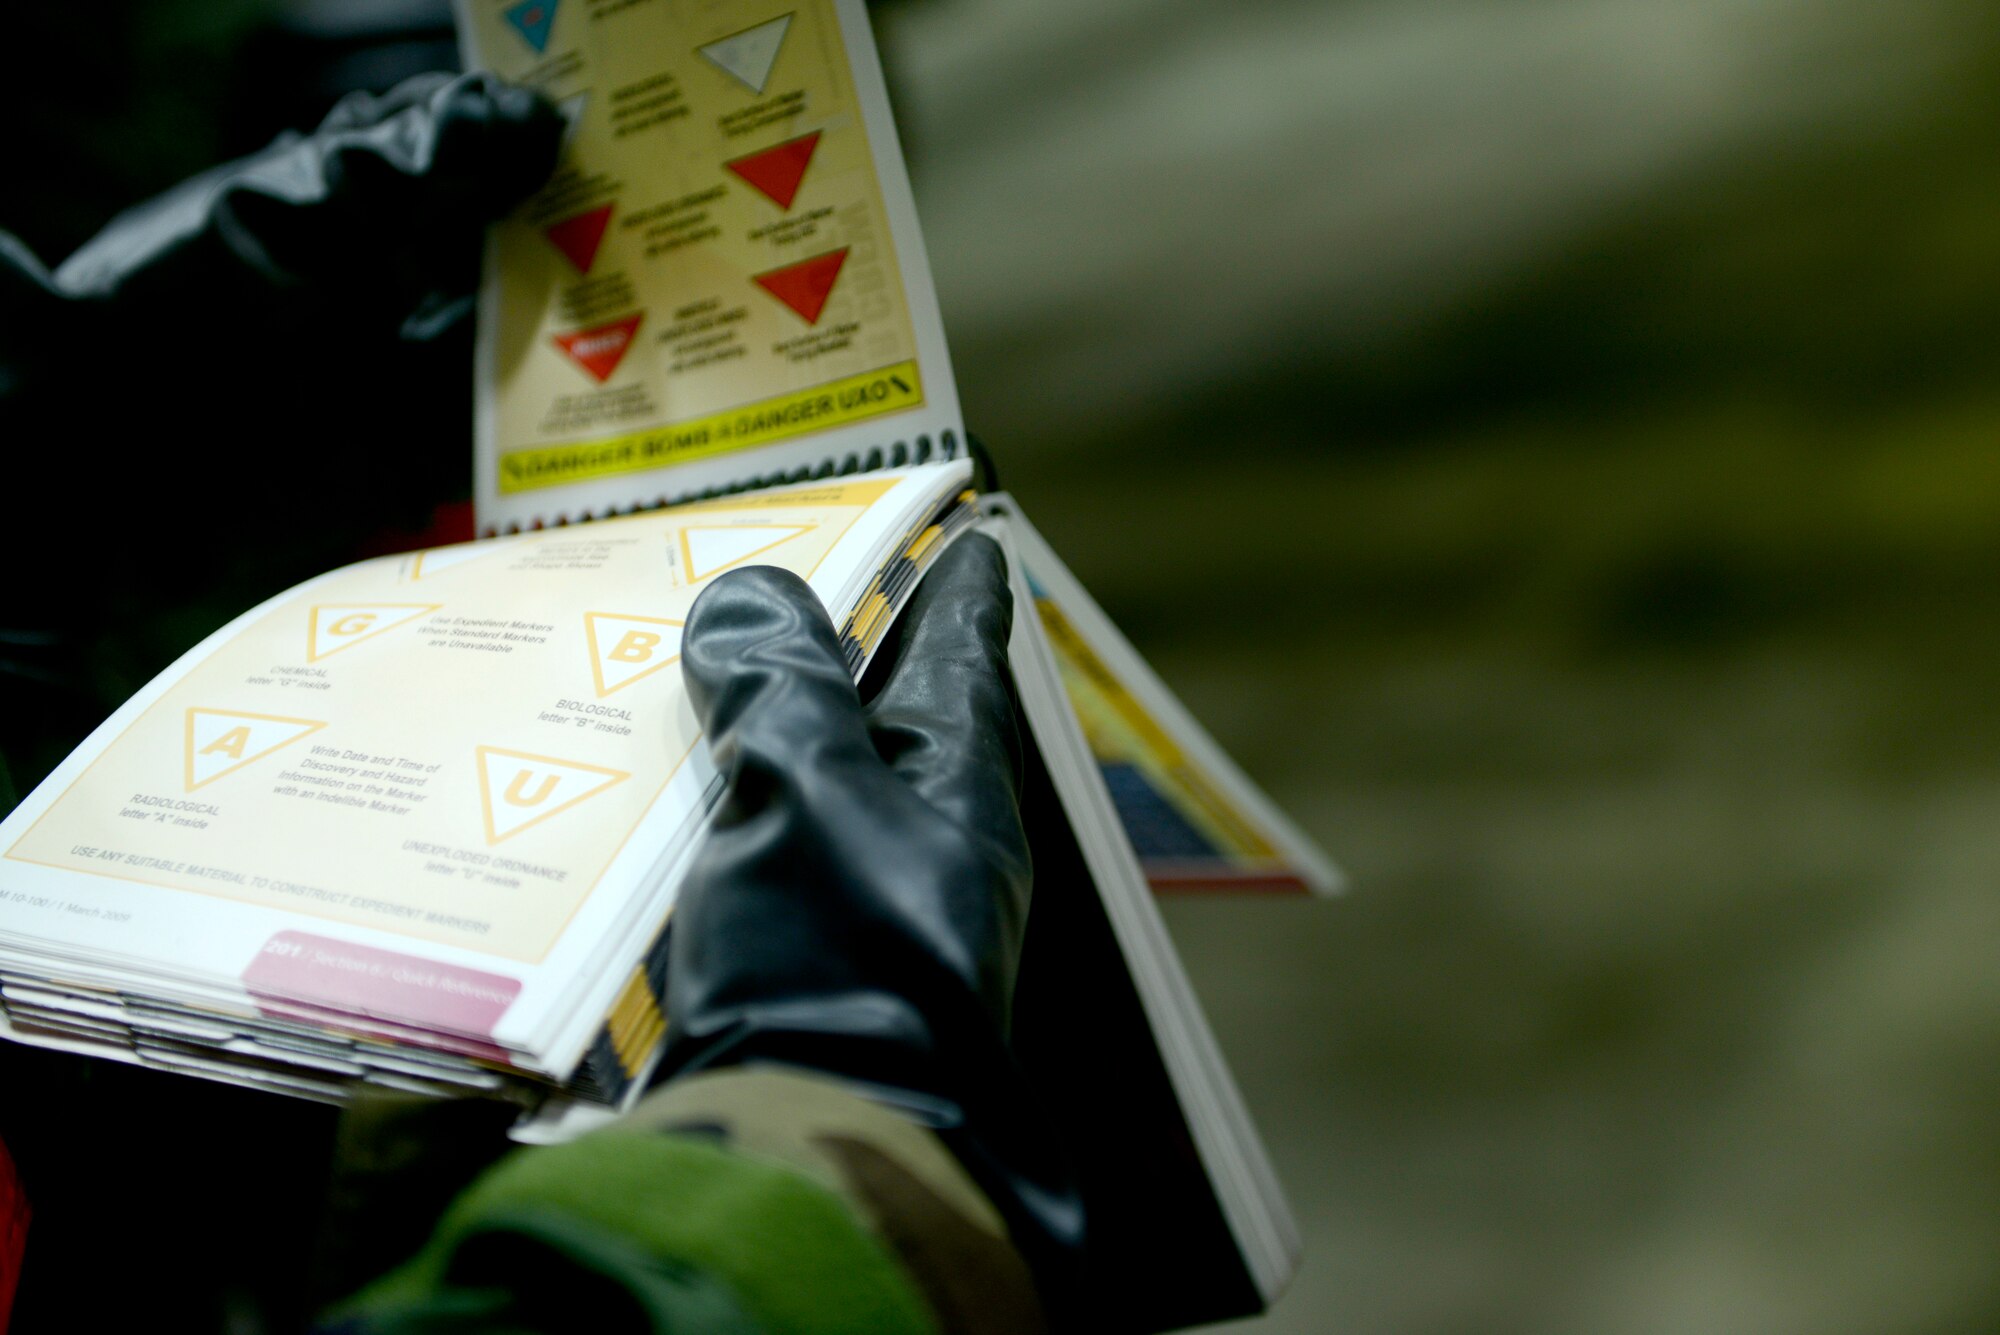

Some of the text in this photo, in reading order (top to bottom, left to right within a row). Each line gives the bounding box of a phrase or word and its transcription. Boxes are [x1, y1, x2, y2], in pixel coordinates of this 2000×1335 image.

[641, 424, 711, 459] BOMB
[733, 394, 837, 440] DANGER
[837, 378, 892, 413] UXO
[327, 613, 377, 636] G
[417, 626, 548, 646] When Standard Markers
[449, 616, 508, 632] Expedient
[508, 619, 555, 633] Markers
[427, 640, 513, 655] are Unavailable
[606, 630, 661, 663] B
[269, 665, 329, 679] CHEMICAL
[297, 679, 332, 691] inside
[537, 710, 632, 737] letter "B" inside
[555, 699, 633, 722] BIOLOGICAL
[198, 726, 251, 759] A
[299, 758, 428, 788] Discovery and Hazard
[309, 744, 443, 776] Write Date and Time of
[272, 783, 412, 816] with an Indelible Marker
[277, 770, 428, 802] Information on the Marker
[503, 769, 562, 807] U
[118, 806, 210, 831] letter "A" inside
[129, 793, 220, 817] RADIOLOGICAL
[402, 839, 570, 884] UNEXPLODED ORDNANCE
[422, 859, 459, 877] letter
[480, 871, 522, 890] inside
[69, 844, 491, 935] USE ANY SUITABLE MATERIAL TO CONSTRUCT EXPEDIENT MARKERS
[65, 903, 101, 918] March
[100, 909, 132, 922] 2009
